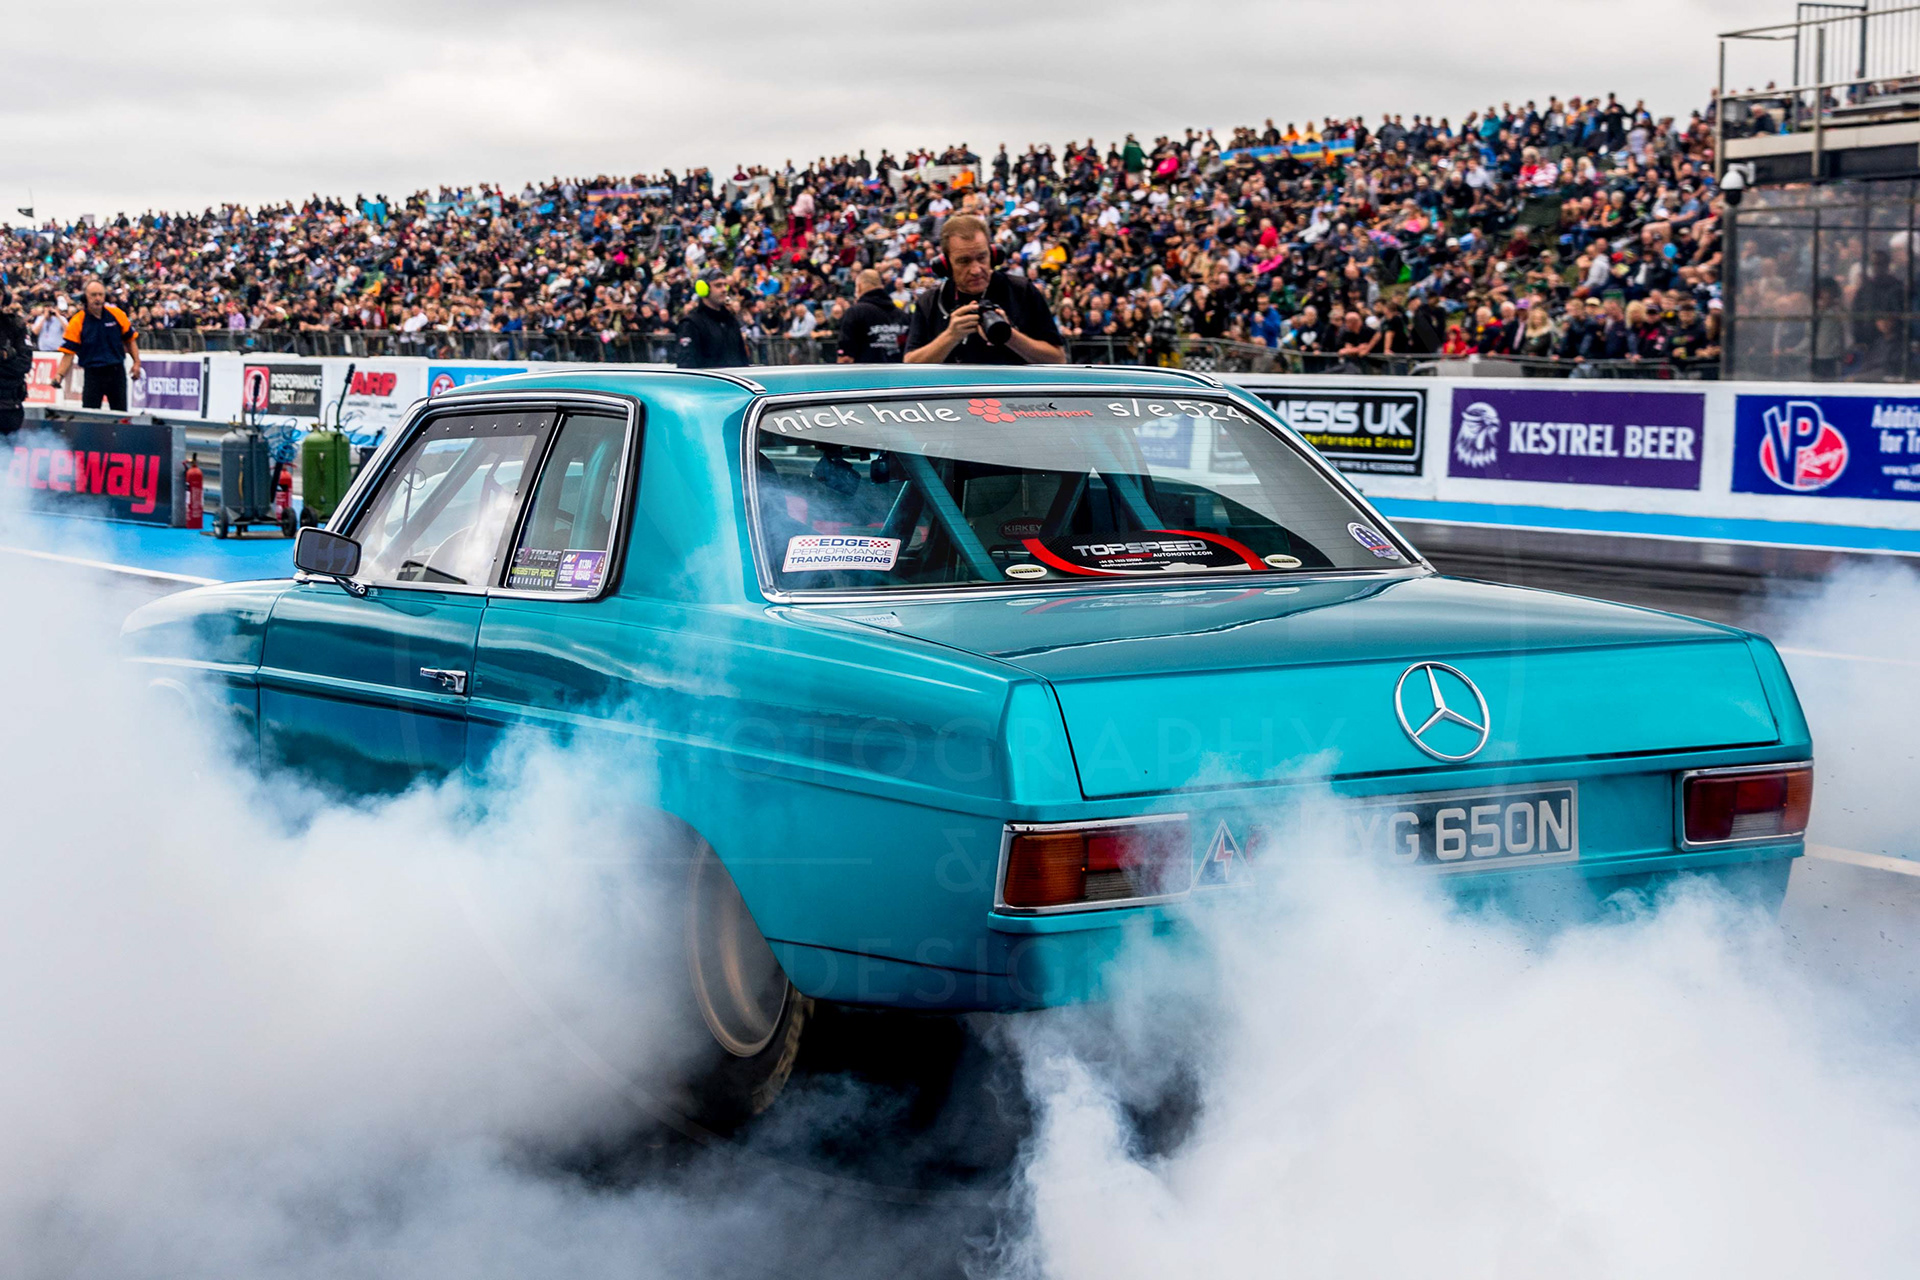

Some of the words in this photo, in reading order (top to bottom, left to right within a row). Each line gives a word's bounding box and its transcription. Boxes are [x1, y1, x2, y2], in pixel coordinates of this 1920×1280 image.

[179, 378, 199, 396] BEER
[270, 373, 322, 390] PERFORMANCE
[349, 371, 398, 397] ARP
[773, 404, 864, 433] nick
[867, 402, 962, 424] hale
[1013, 409, 1094, 419] Motorsport
[1172, 400, 1250, 426] 524
[1363, 402, 1414, 436] UK
[1508, 421, 1618, 459] KESTREL
[1623, 426, 1695, 462] BEER
[5, 446, 161, 515] aceway
[1004, 524, 1042, 533] KIRKEY
[792, 547, 894, 557] PERFORMANCE
[818, 538, 871, 548] EDGE
[1072, 539, 1208, 557] TOPSPEED
[790, 555, 892, 565] TRANSMISSIONS
[1435, 798, 1570, 861] 650N
